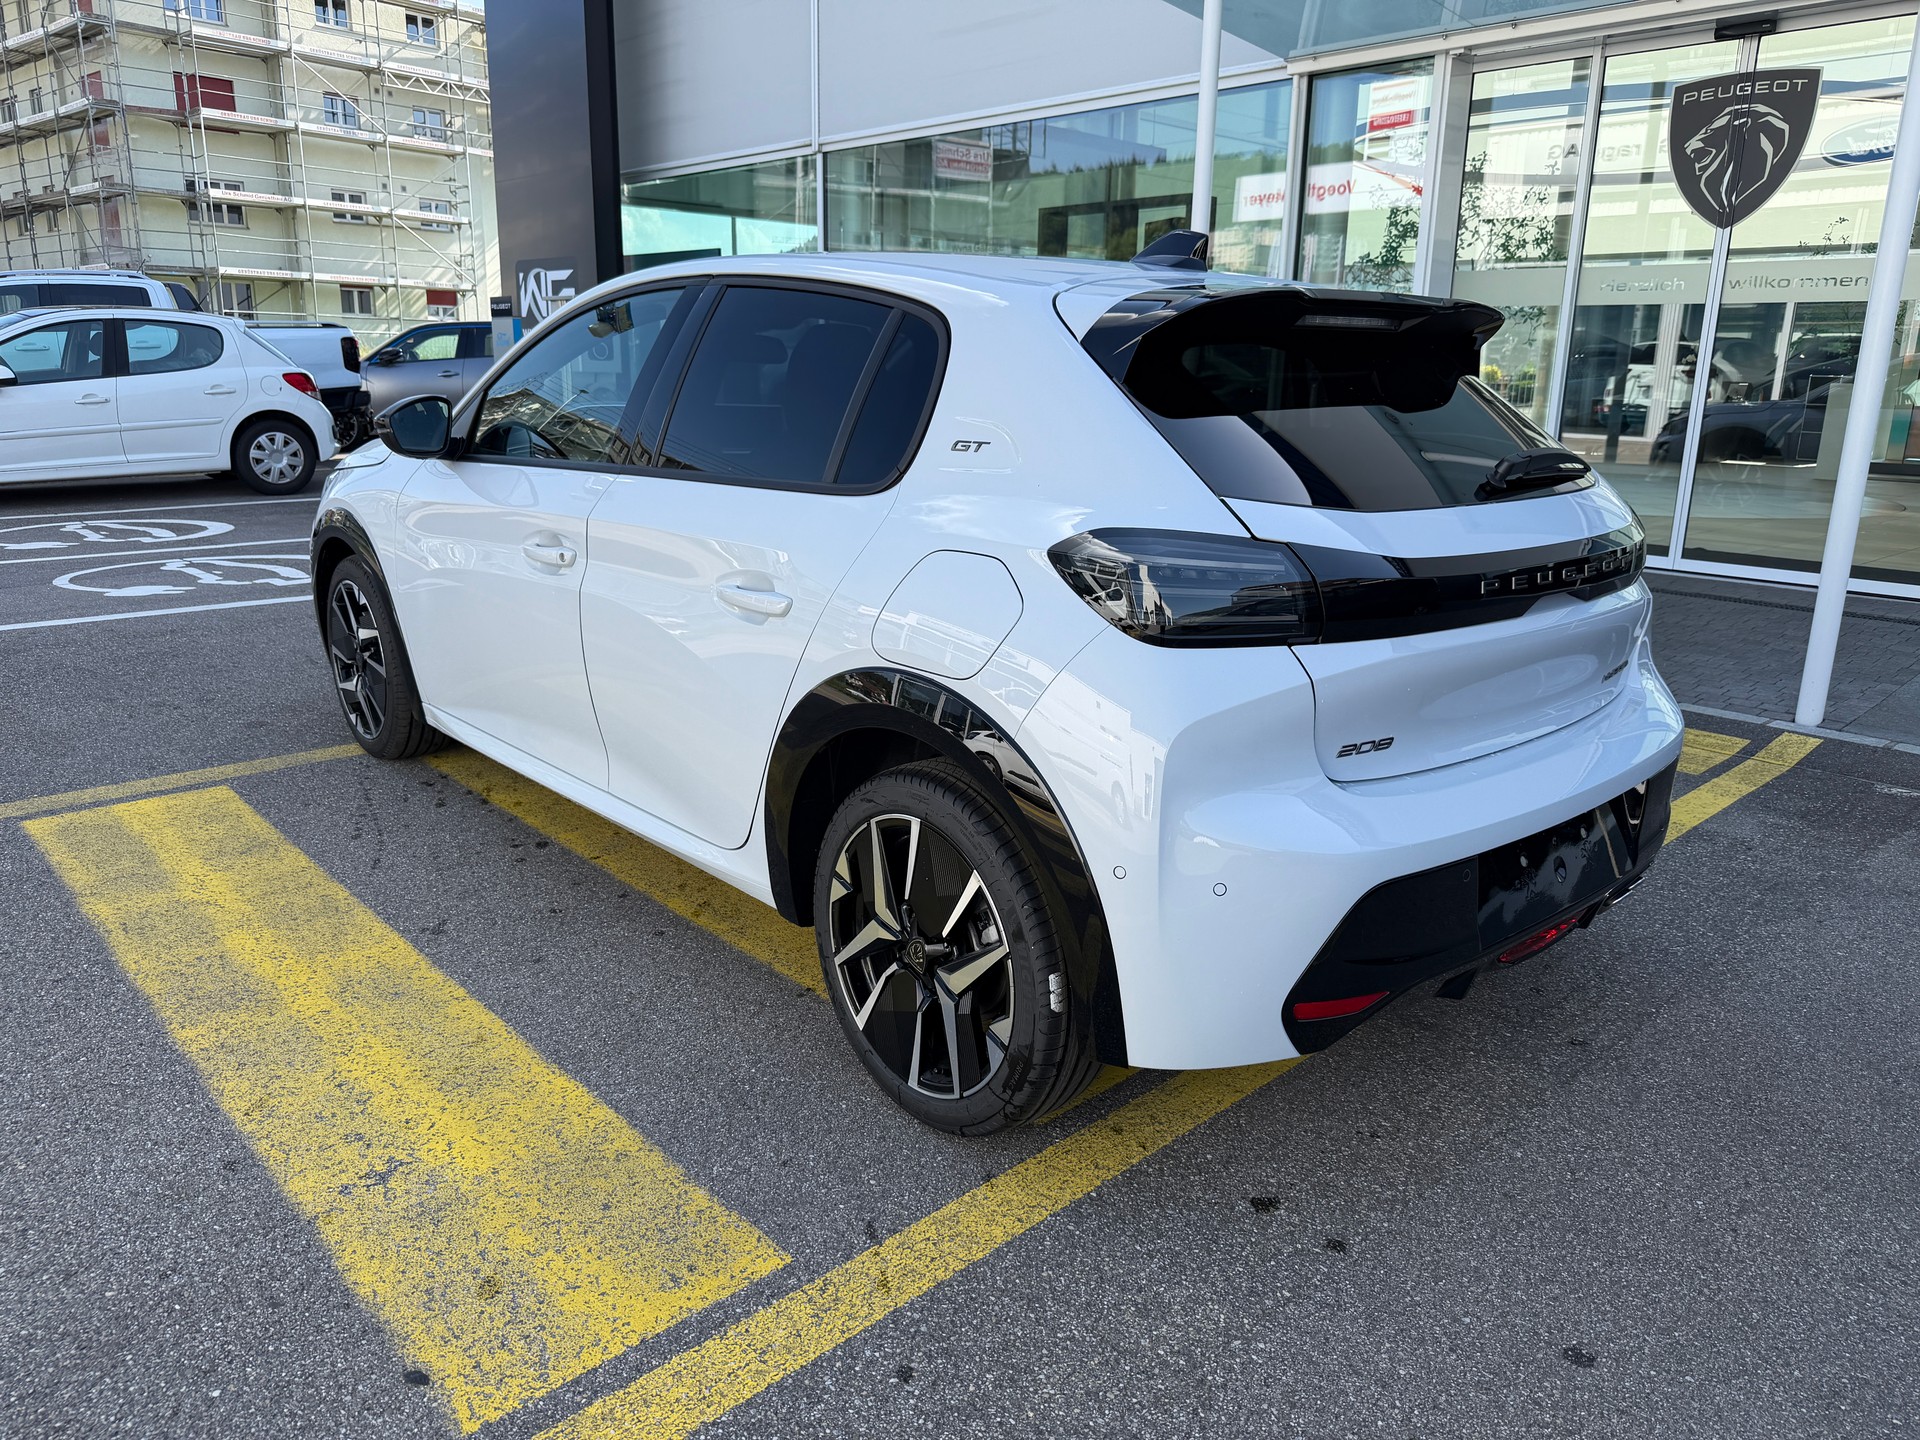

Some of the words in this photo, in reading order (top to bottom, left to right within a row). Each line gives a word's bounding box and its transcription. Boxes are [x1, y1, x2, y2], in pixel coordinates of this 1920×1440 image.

[1682, 79, 1809, 106] PEUGEOT
[1600, 278, 1685, 292] Herzlich
[1728, 276, 1869, 289] willkommen
[951, 440, 991, 453] GT
[1481, 555, 1633, 594] PEUGEOT
[1336, 737, 1394, 758] 208
